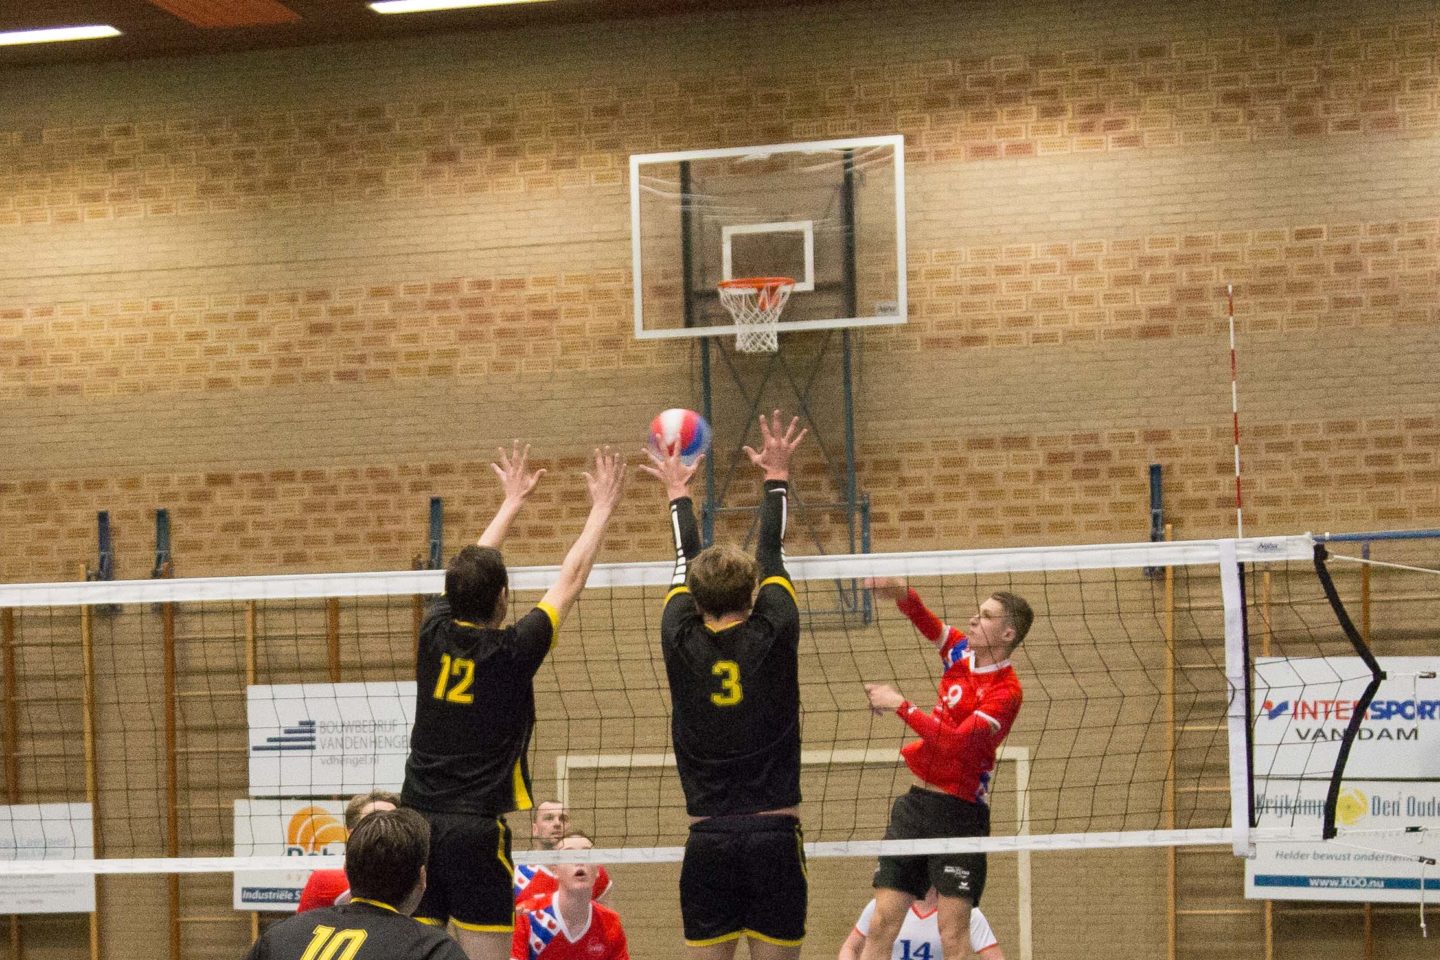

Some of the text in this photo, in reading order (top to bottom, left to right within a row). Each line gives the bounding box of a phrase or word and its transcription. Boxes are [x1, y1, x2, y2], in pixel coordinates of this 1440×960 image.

[433, 652, 475, 704] 12
[710, 660, 743, 707] 3
[947, 684, 963, 709] 9
[319, 719, 398, 734] BOUWBEDRIJF
[1295, 727, 1419, 741] VAN DAM
[1372, 795, 1400, 817] Den
[1312, 852, 1351, 862] bewust
[1310, 877, 1385, 889] www.KDO.nu
